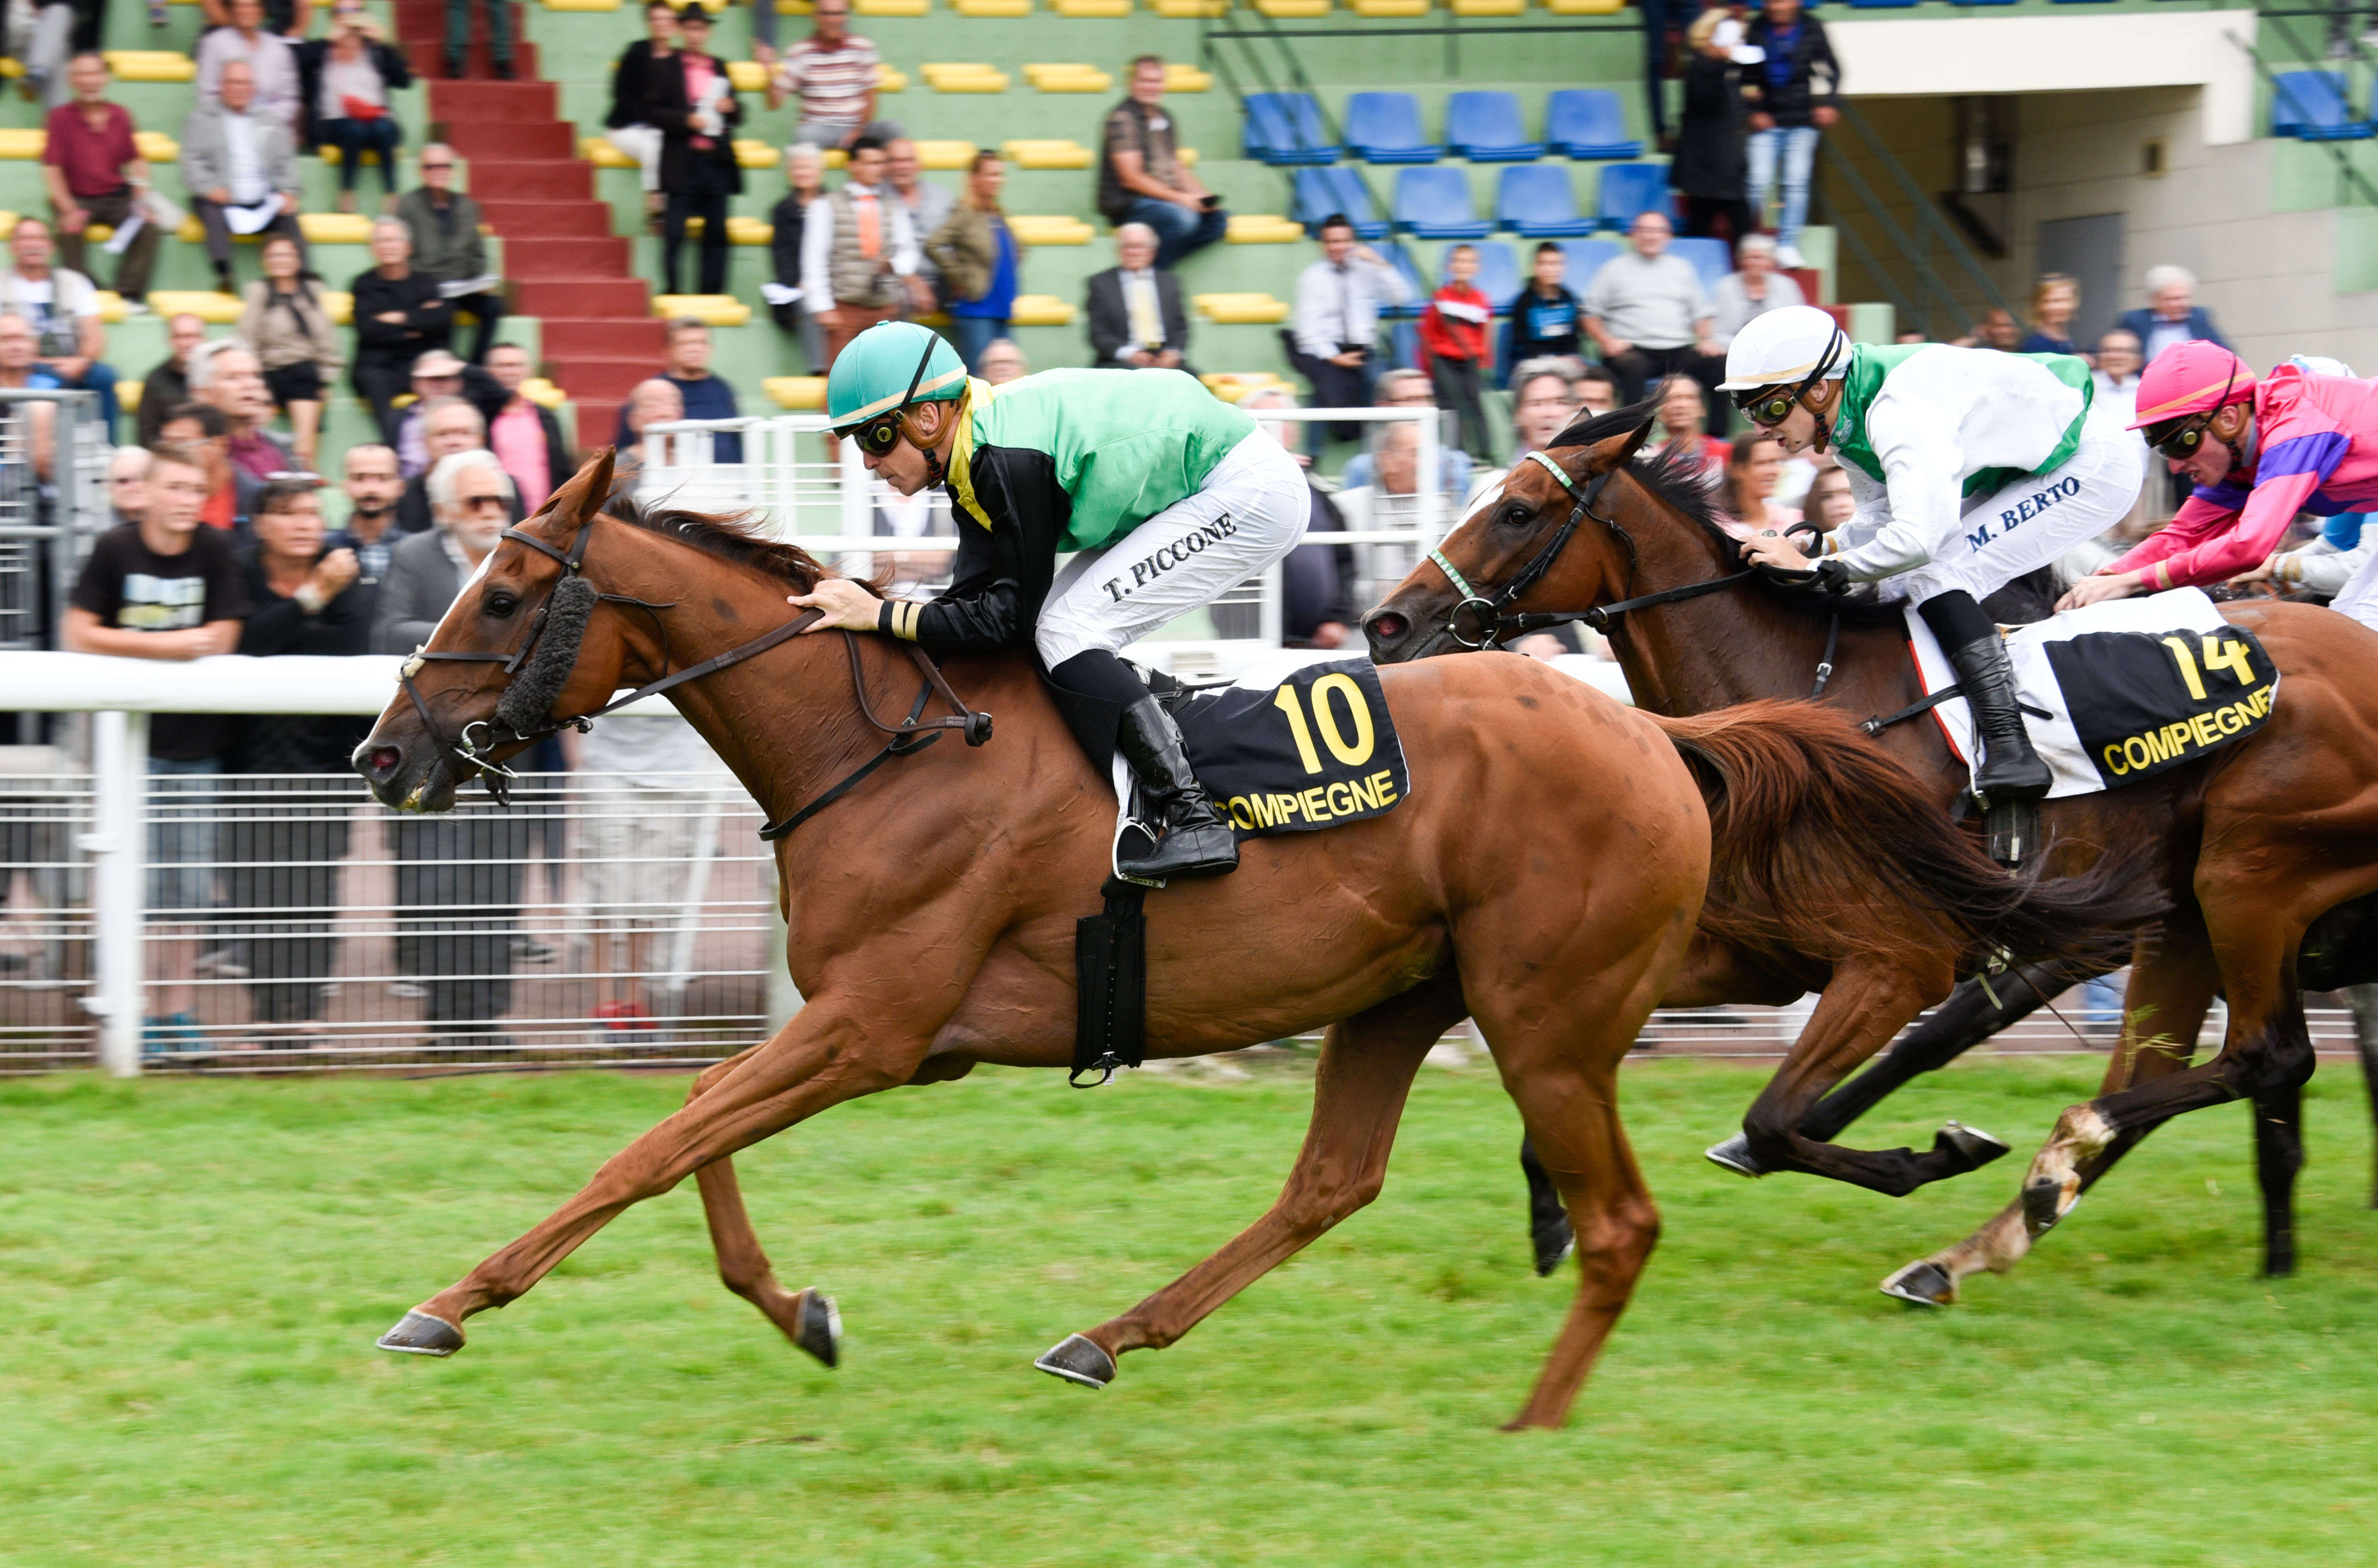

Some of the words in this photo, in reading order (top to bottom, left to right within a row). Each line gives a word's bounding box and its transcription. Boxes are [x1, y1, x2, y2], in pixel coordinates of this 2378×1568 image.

[1102, 577, 1133, 603] T.
[1129, 512, 1238, 588] PICCONE
[1965, 524, 1998, 553] M.
[2000, 476, 2080, 532] BERTO
[2161, 636, 2256, 700] 14
[1274, 673, 1374, 774] 10
[2103, 685, 2271, 776] COMPIEGNE
